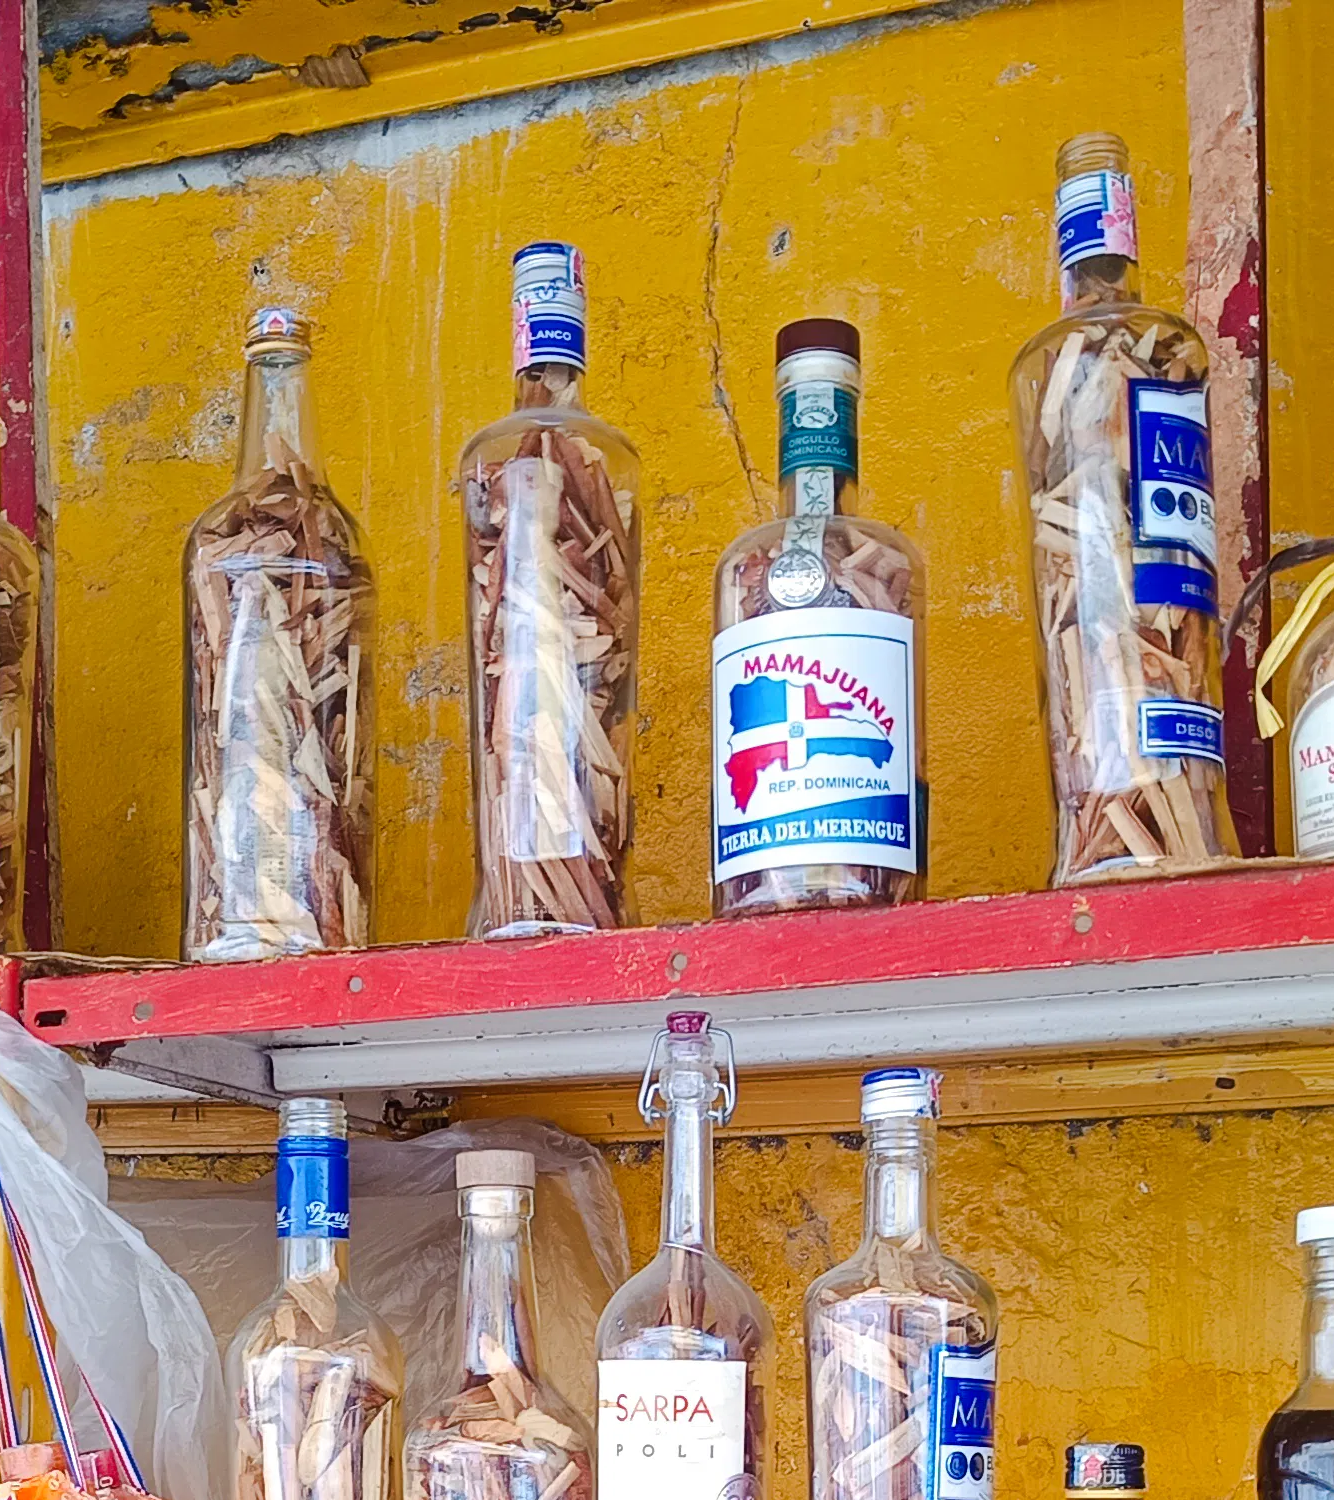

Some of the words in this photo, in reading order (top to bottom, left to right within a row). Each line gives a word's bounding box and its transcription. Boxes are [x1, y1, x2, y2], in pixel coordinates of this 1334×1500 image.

[743, 653, 896, 737] MAMAJUANA
[769, 779, 801, 794] REP.
[804, 776, 890, 792] DOMINICANA
[722, 824, 772, 856] TIERRA
[774, 820, 811, 840] DEL
[813, 818, 906, 842] MERENGUE
[616, 1394, 714, 1422] SARPA
[616, 1442, 715, 1460] POLI
